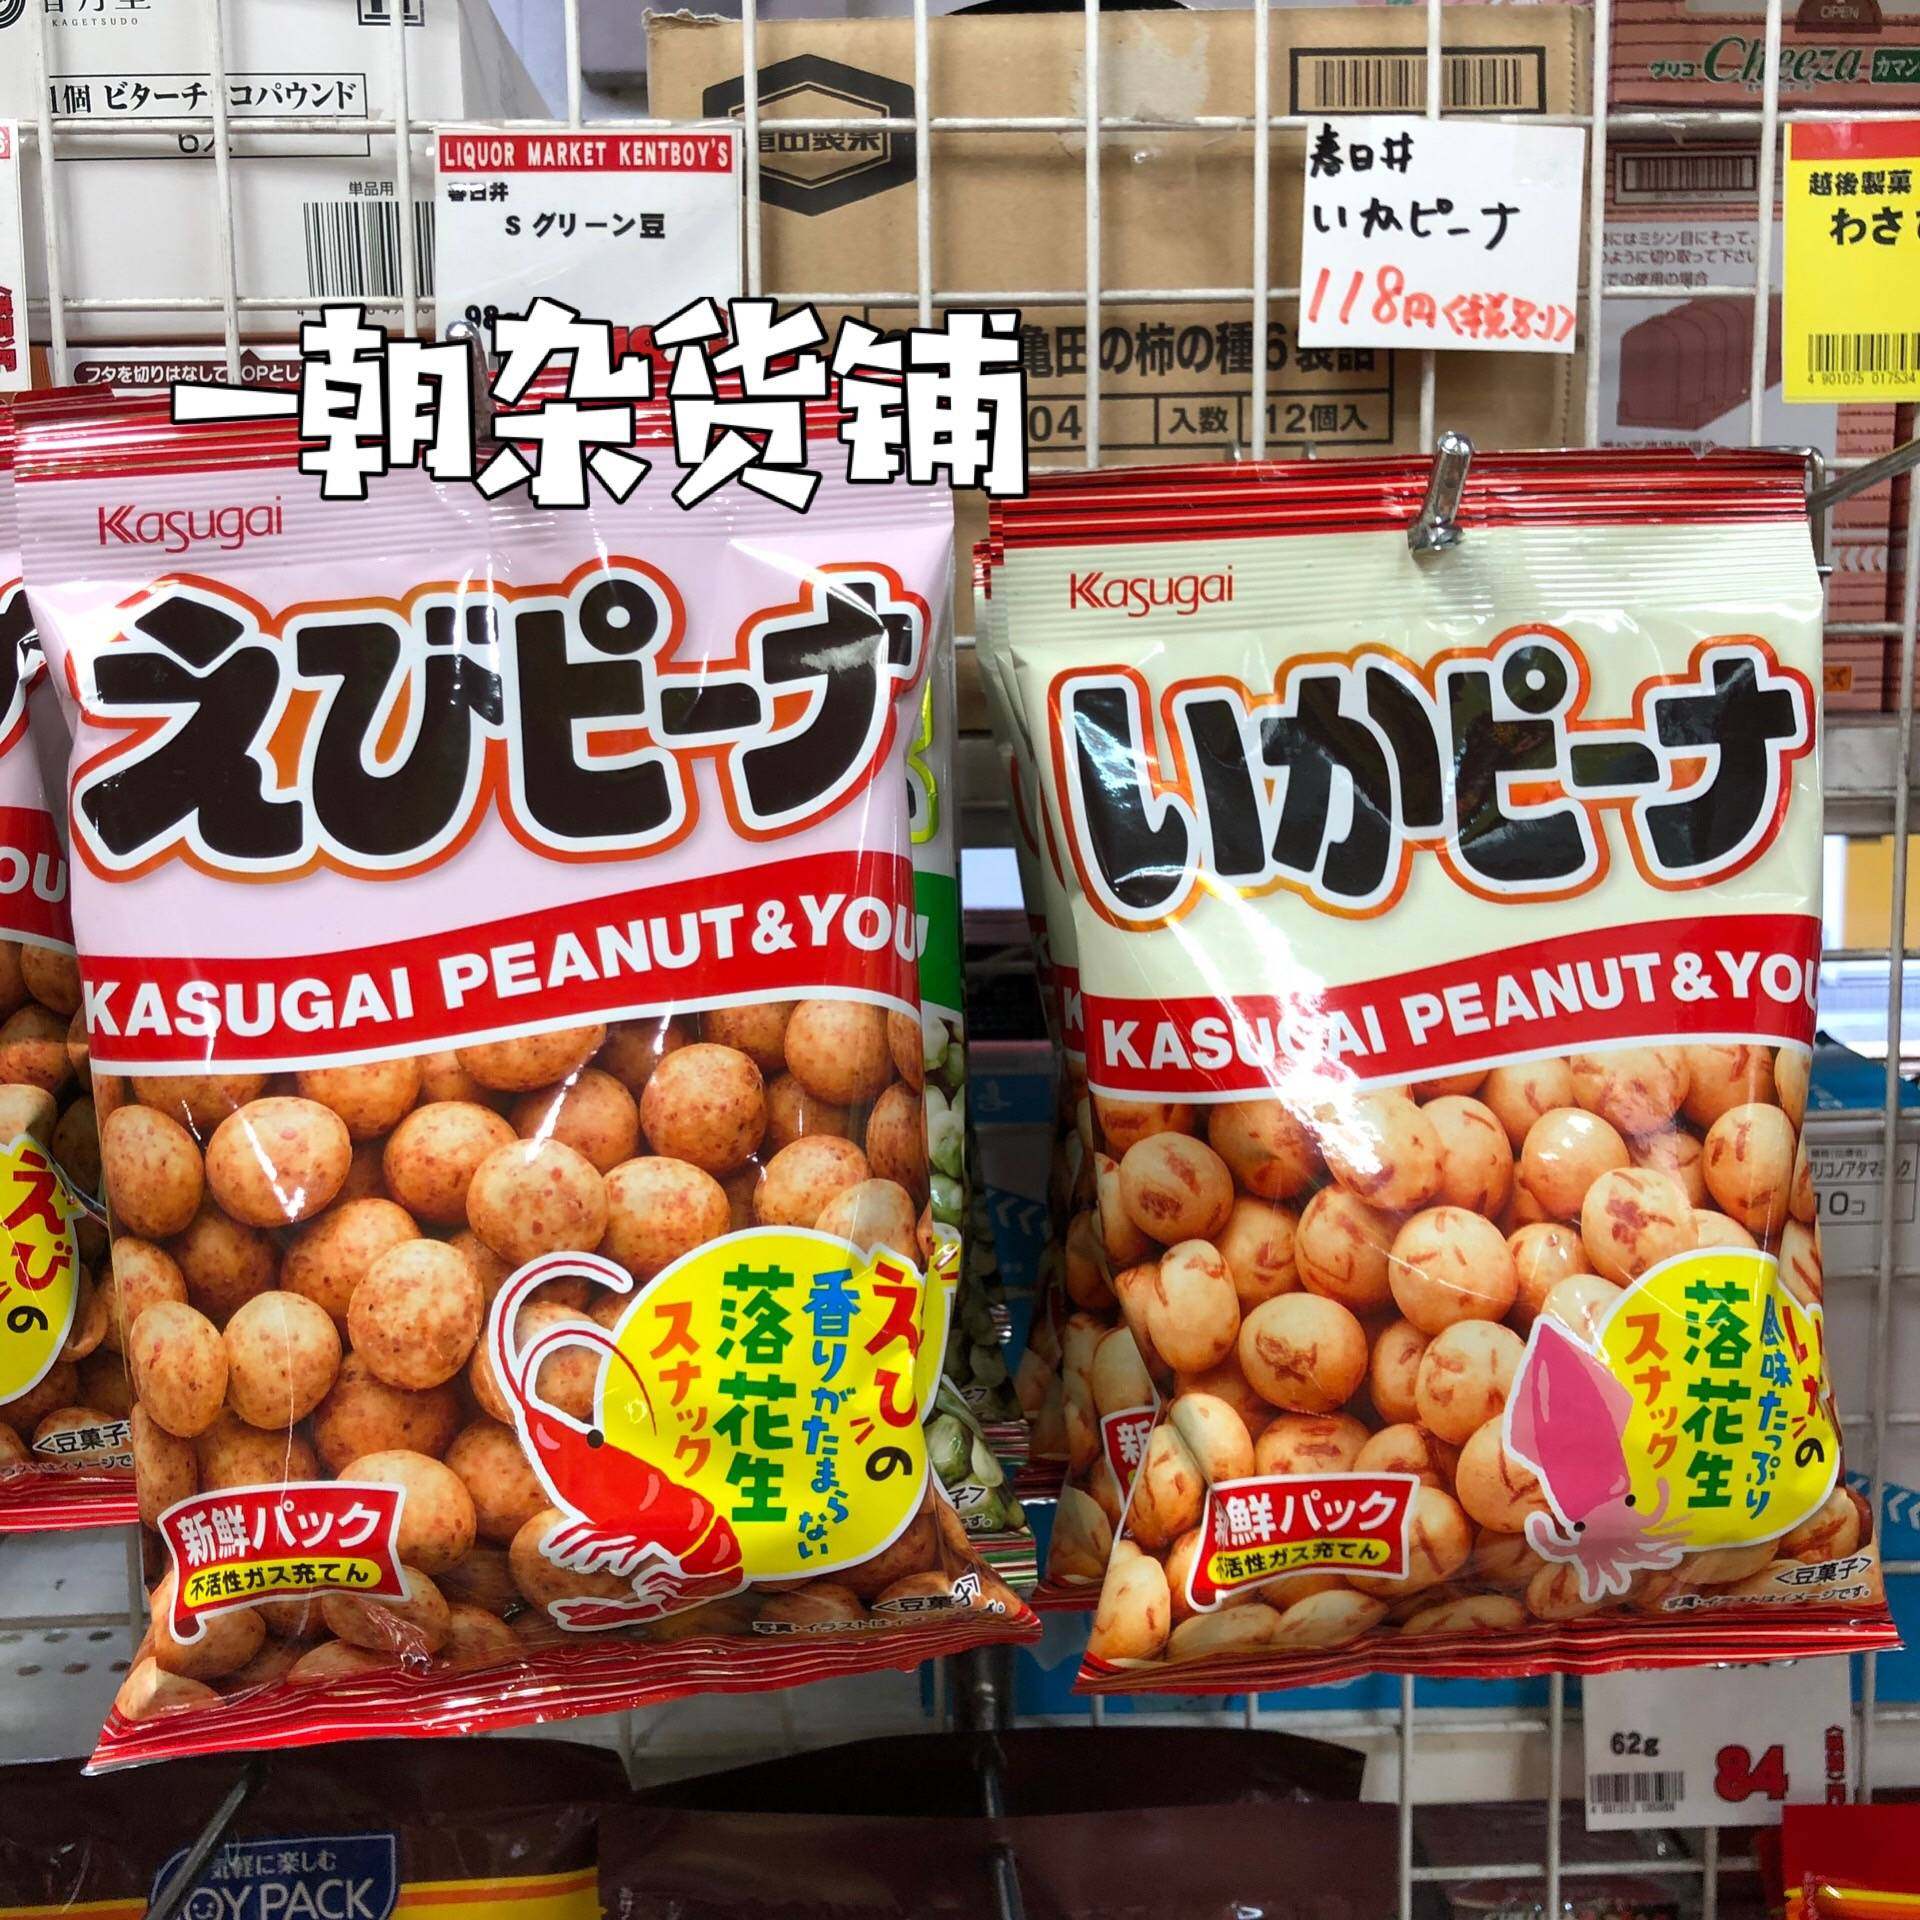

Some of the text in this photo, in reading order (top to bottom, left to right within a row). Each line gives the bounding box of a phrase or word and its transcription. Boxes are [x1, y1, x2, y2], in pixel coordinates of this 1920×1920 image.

[52, 17, 138, 27] KAGETSUDO
[104, 81, 356, 111] ビターチコパウンド
[445, 138, 728, 169] LIQUOR MARKET KENTBOY'S
[349, 181, 394, 197] 単品用
[1809, 170, 1912, 196] 越後製菓
[505, 213, 666, 239] S グリーン豆
[1830, 206, 1920, 245] わさ
[1168, 407, 1229, 435] 入数
[98, 496, 283, 554] Kasugai
[1069, 565, 1234, 618] Kasugai
[76, 570, 920, 868] えびピーナ
[1068, 638, 1802, 914] いかピーナ
[84, 967, 414, 1037] KASUGAI
[438, 893, 930, 1009] PEANUT&YOU
[650, 1301, 712, 1479] スナック
[712, 1264, 797, 1523] 落花生
[1625, 1313, 1679, 1469] スナック
[1682, 1280, 1751, 1509] 落花生
[177, 1500, 382, 1567] 新鮮パック
[190, 1563, 369, 1601] 不活性ガス充てん
[1610, 1730, 1660, 1757] 62g
[1713, 1744, 1790, 1802] 84
[184, 1886, 252, 1920] OY
